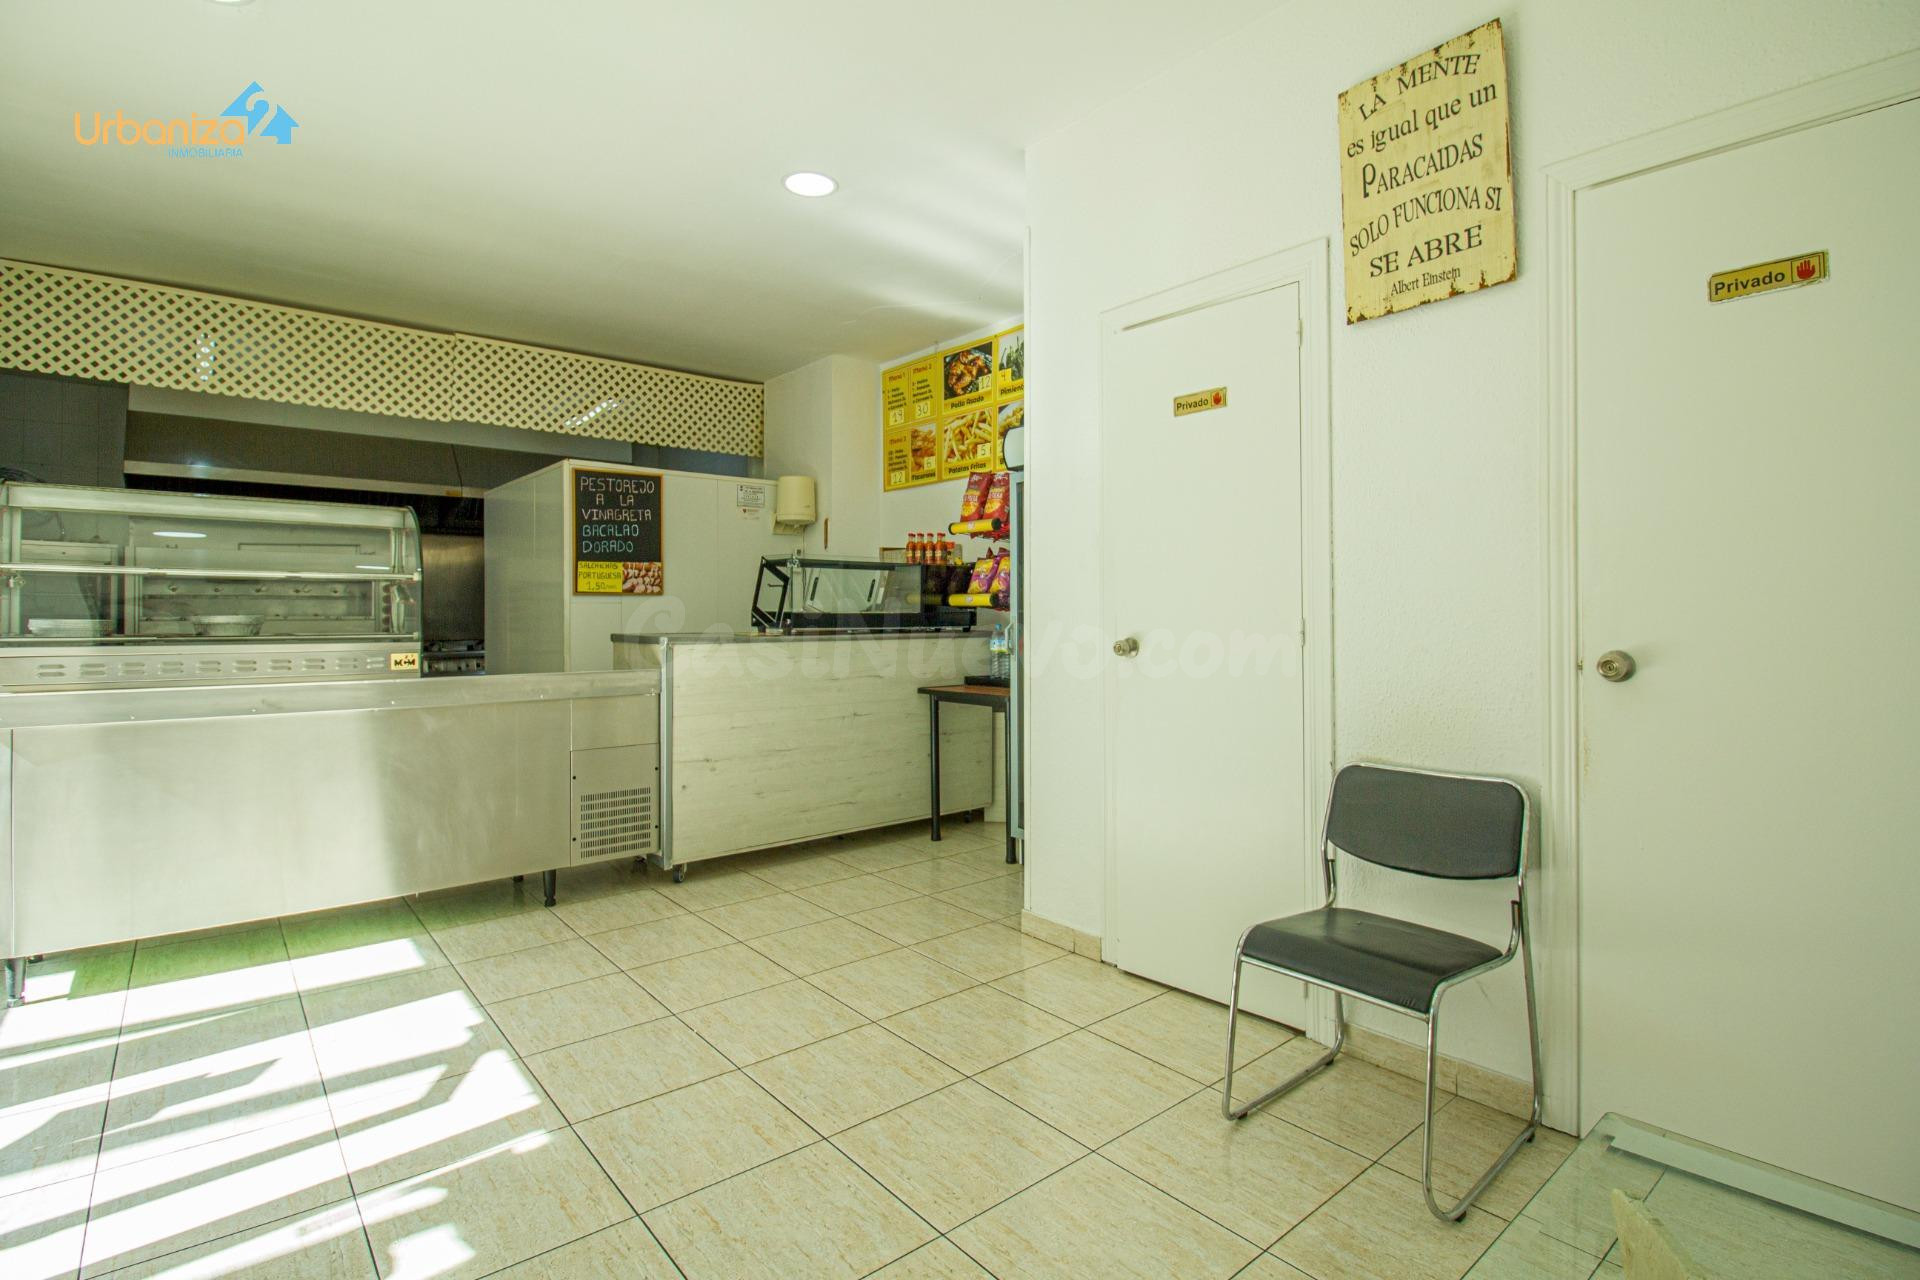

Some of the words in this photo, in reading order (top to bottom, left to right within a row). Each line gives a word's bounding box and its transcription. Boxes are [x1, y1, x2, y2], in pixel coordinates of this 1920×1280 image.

[1358, 93, 1387, 121] LA
[1396, 53, 1481, 96] MENTE
[1346, 138, 1365, 158] es
[1370, 109, 1420, 153] igual
[1424, 97, 1461, 131] que
[1468, 82, 1498, 108] un
[1349, 213, 1390, 257] SOLO
[1392, 185, 1482, 229] FUNCIONA
[1484, 186, 1503, 212] SI
[1369, 250, 1400, 278] SE
[1407, 224, 1483, 268] ABRE
[1390, 278, 1420, 297] Albert
[1421, 266, 1461, 288] Einstein
[1714, 271, 1786, 296] Privado
[980, 376, 991, 389] 12
[916, 402, 929, 416] 30
[950, 400, 966, 409] Pollo
[1176, 397, 1209, 411] Privado
[892, 471, 903, 483] 12
[580, 477, 655, 493] PESTOREJO
[596, 493, 605, 505] A
[619, 494, 635, 506] LA
[581, 508, 652, 522] VINAGRETA
[582, 524, 639, 537] BACALAO
[582, 540, 634, 553] DORADO
